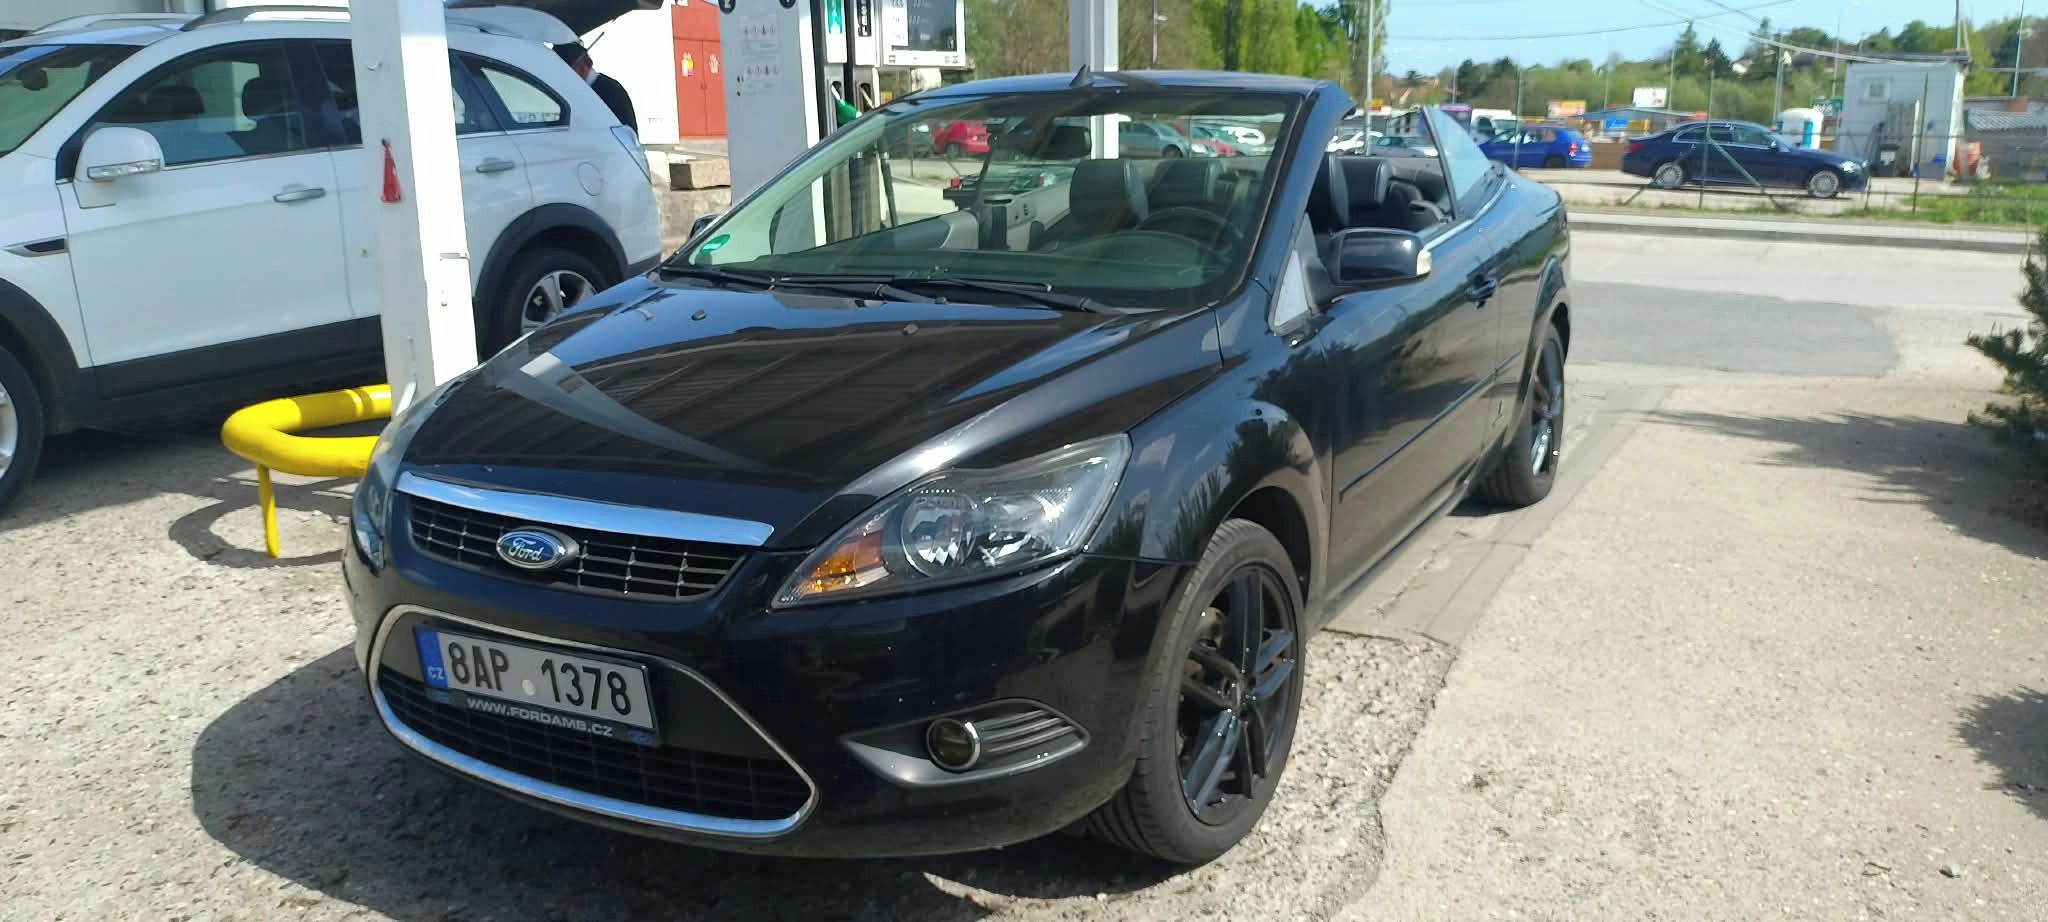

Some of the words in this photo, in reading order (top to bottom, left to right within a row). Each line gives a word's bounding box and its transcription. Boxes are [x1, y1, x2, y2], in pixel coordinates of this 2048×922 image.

[508, 537, 545, 561] Ford
[428, 665, 445, 681] CZ
[448, 641, 509, 692] 8AP
[541, 658, 632, 716] 1378
[466, 697, 614, 738] WWW.FORDAMB.CZ
